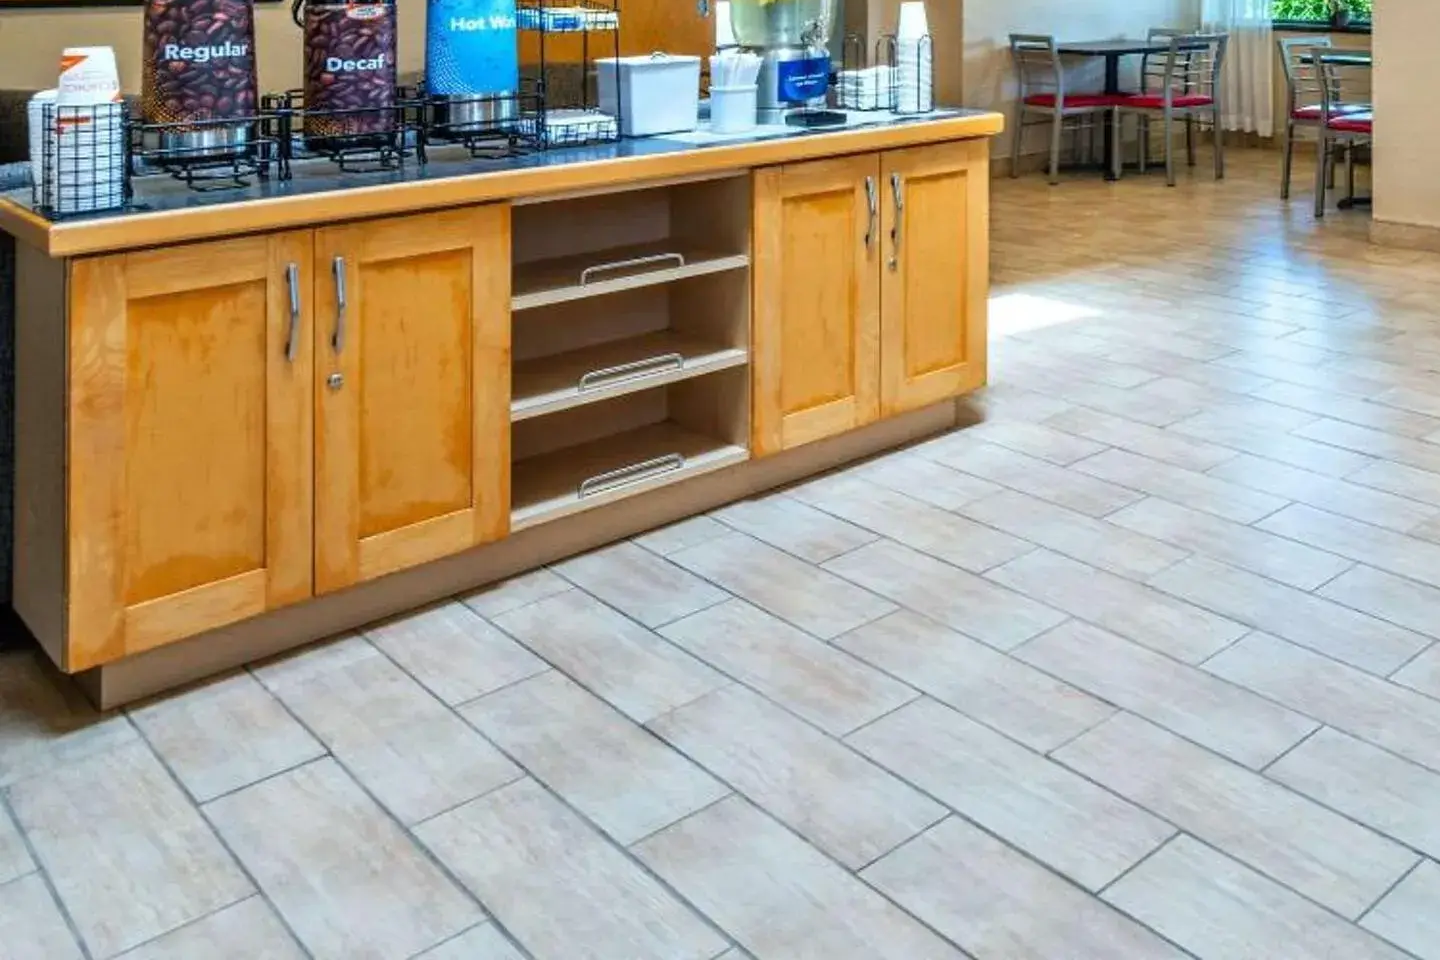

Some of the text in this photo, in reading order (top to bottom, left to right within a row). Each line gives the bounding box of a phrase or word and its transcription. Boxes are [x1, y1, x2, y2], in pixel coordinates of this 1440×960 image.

[450, 17, 484, 31] Hot
[165, 41, 248, 62] Regular
[326, 53, 385, 72] Decaf
